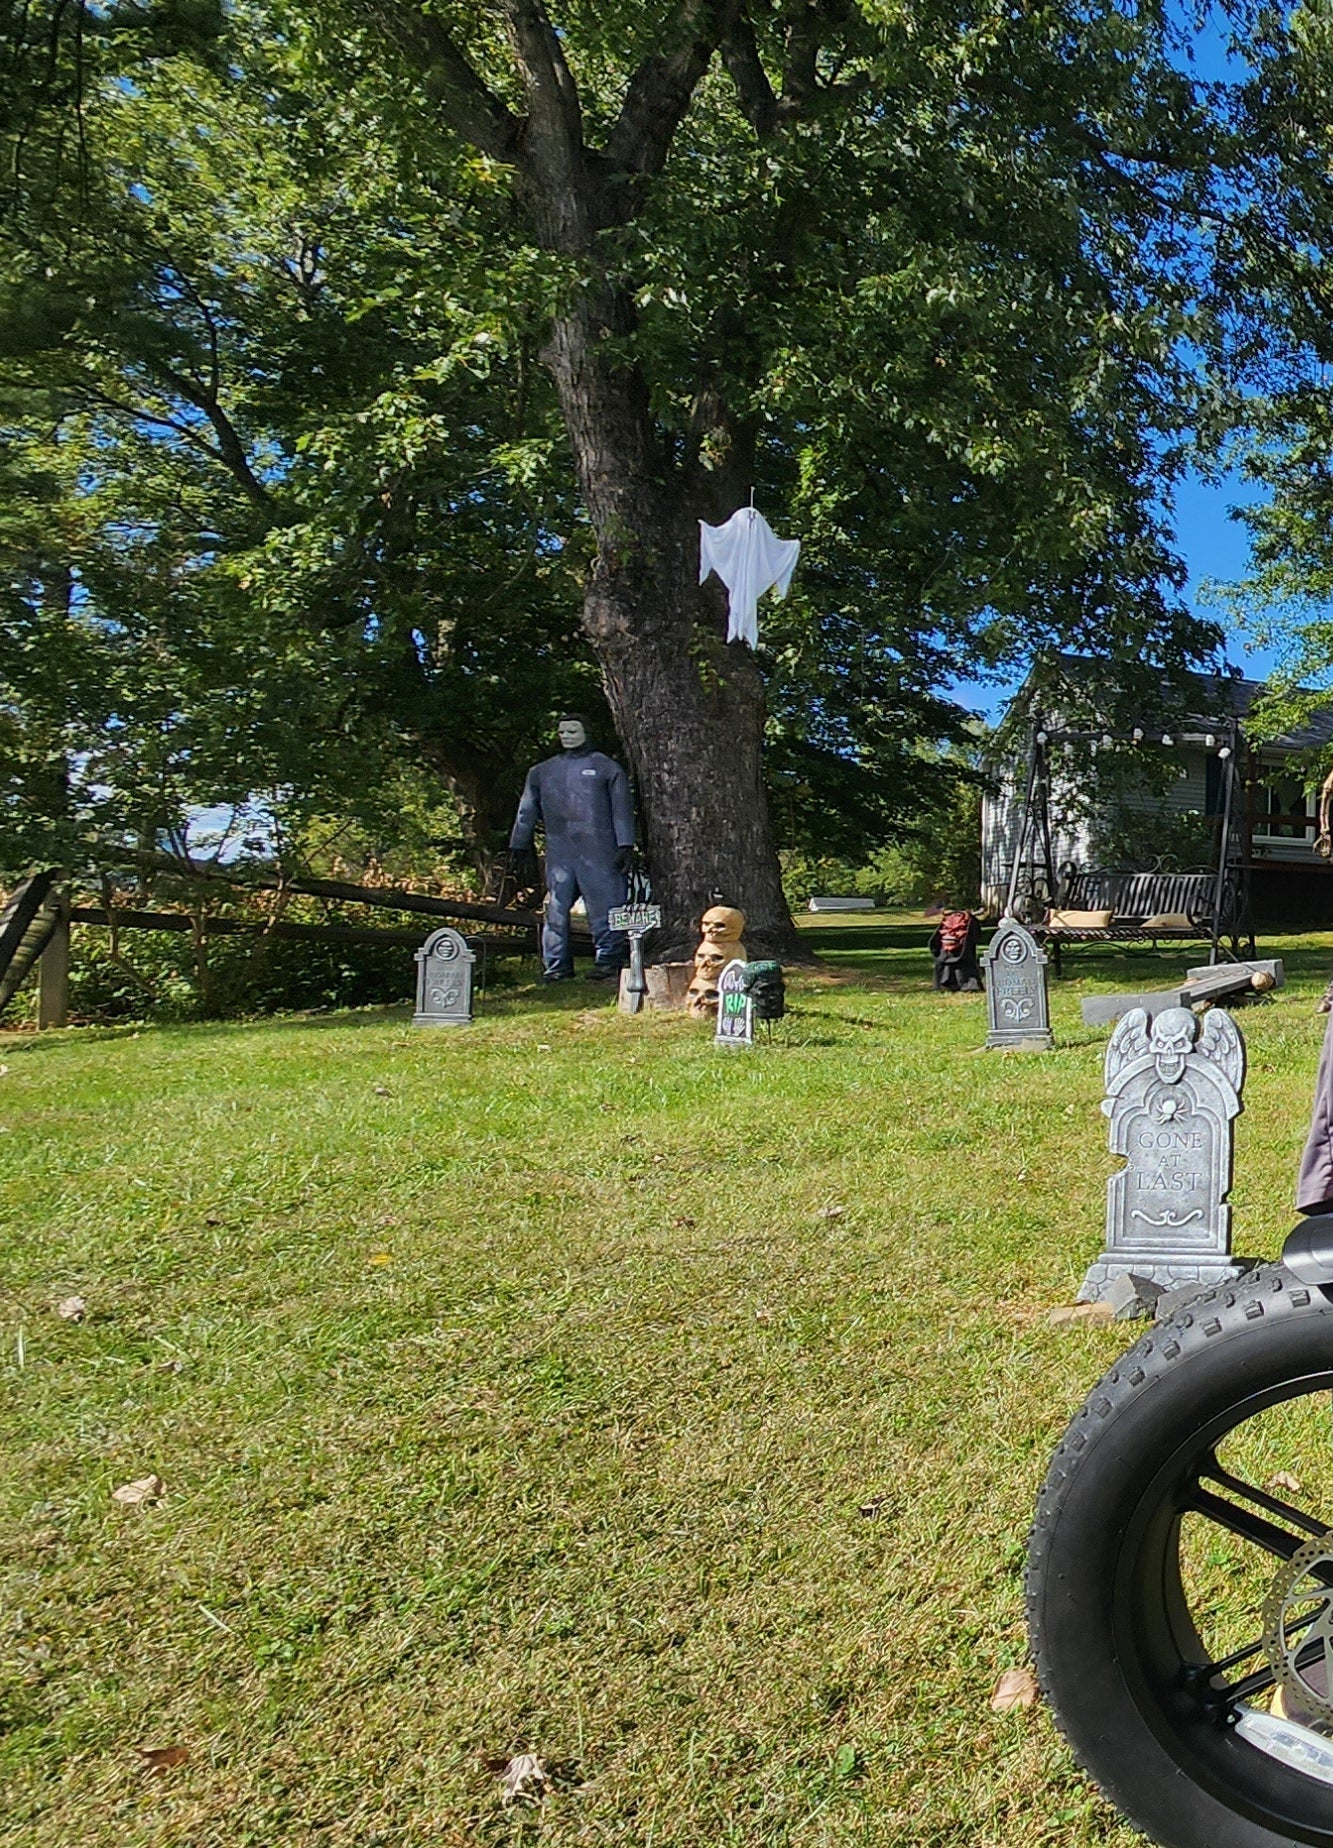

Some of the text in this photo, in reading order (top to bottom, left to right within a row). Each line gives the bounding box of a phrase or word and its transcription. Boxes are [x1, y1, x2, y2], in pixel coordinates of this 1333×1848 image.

[613, 911, 658, 928] BEWARE
[725, 993, 747, 1014] RIP
[1138, 1131, 1203, 1149] GONE
[1159, 1154, 1182, 1167] AT
[1136, 1171, 1203, 1192] LAST
